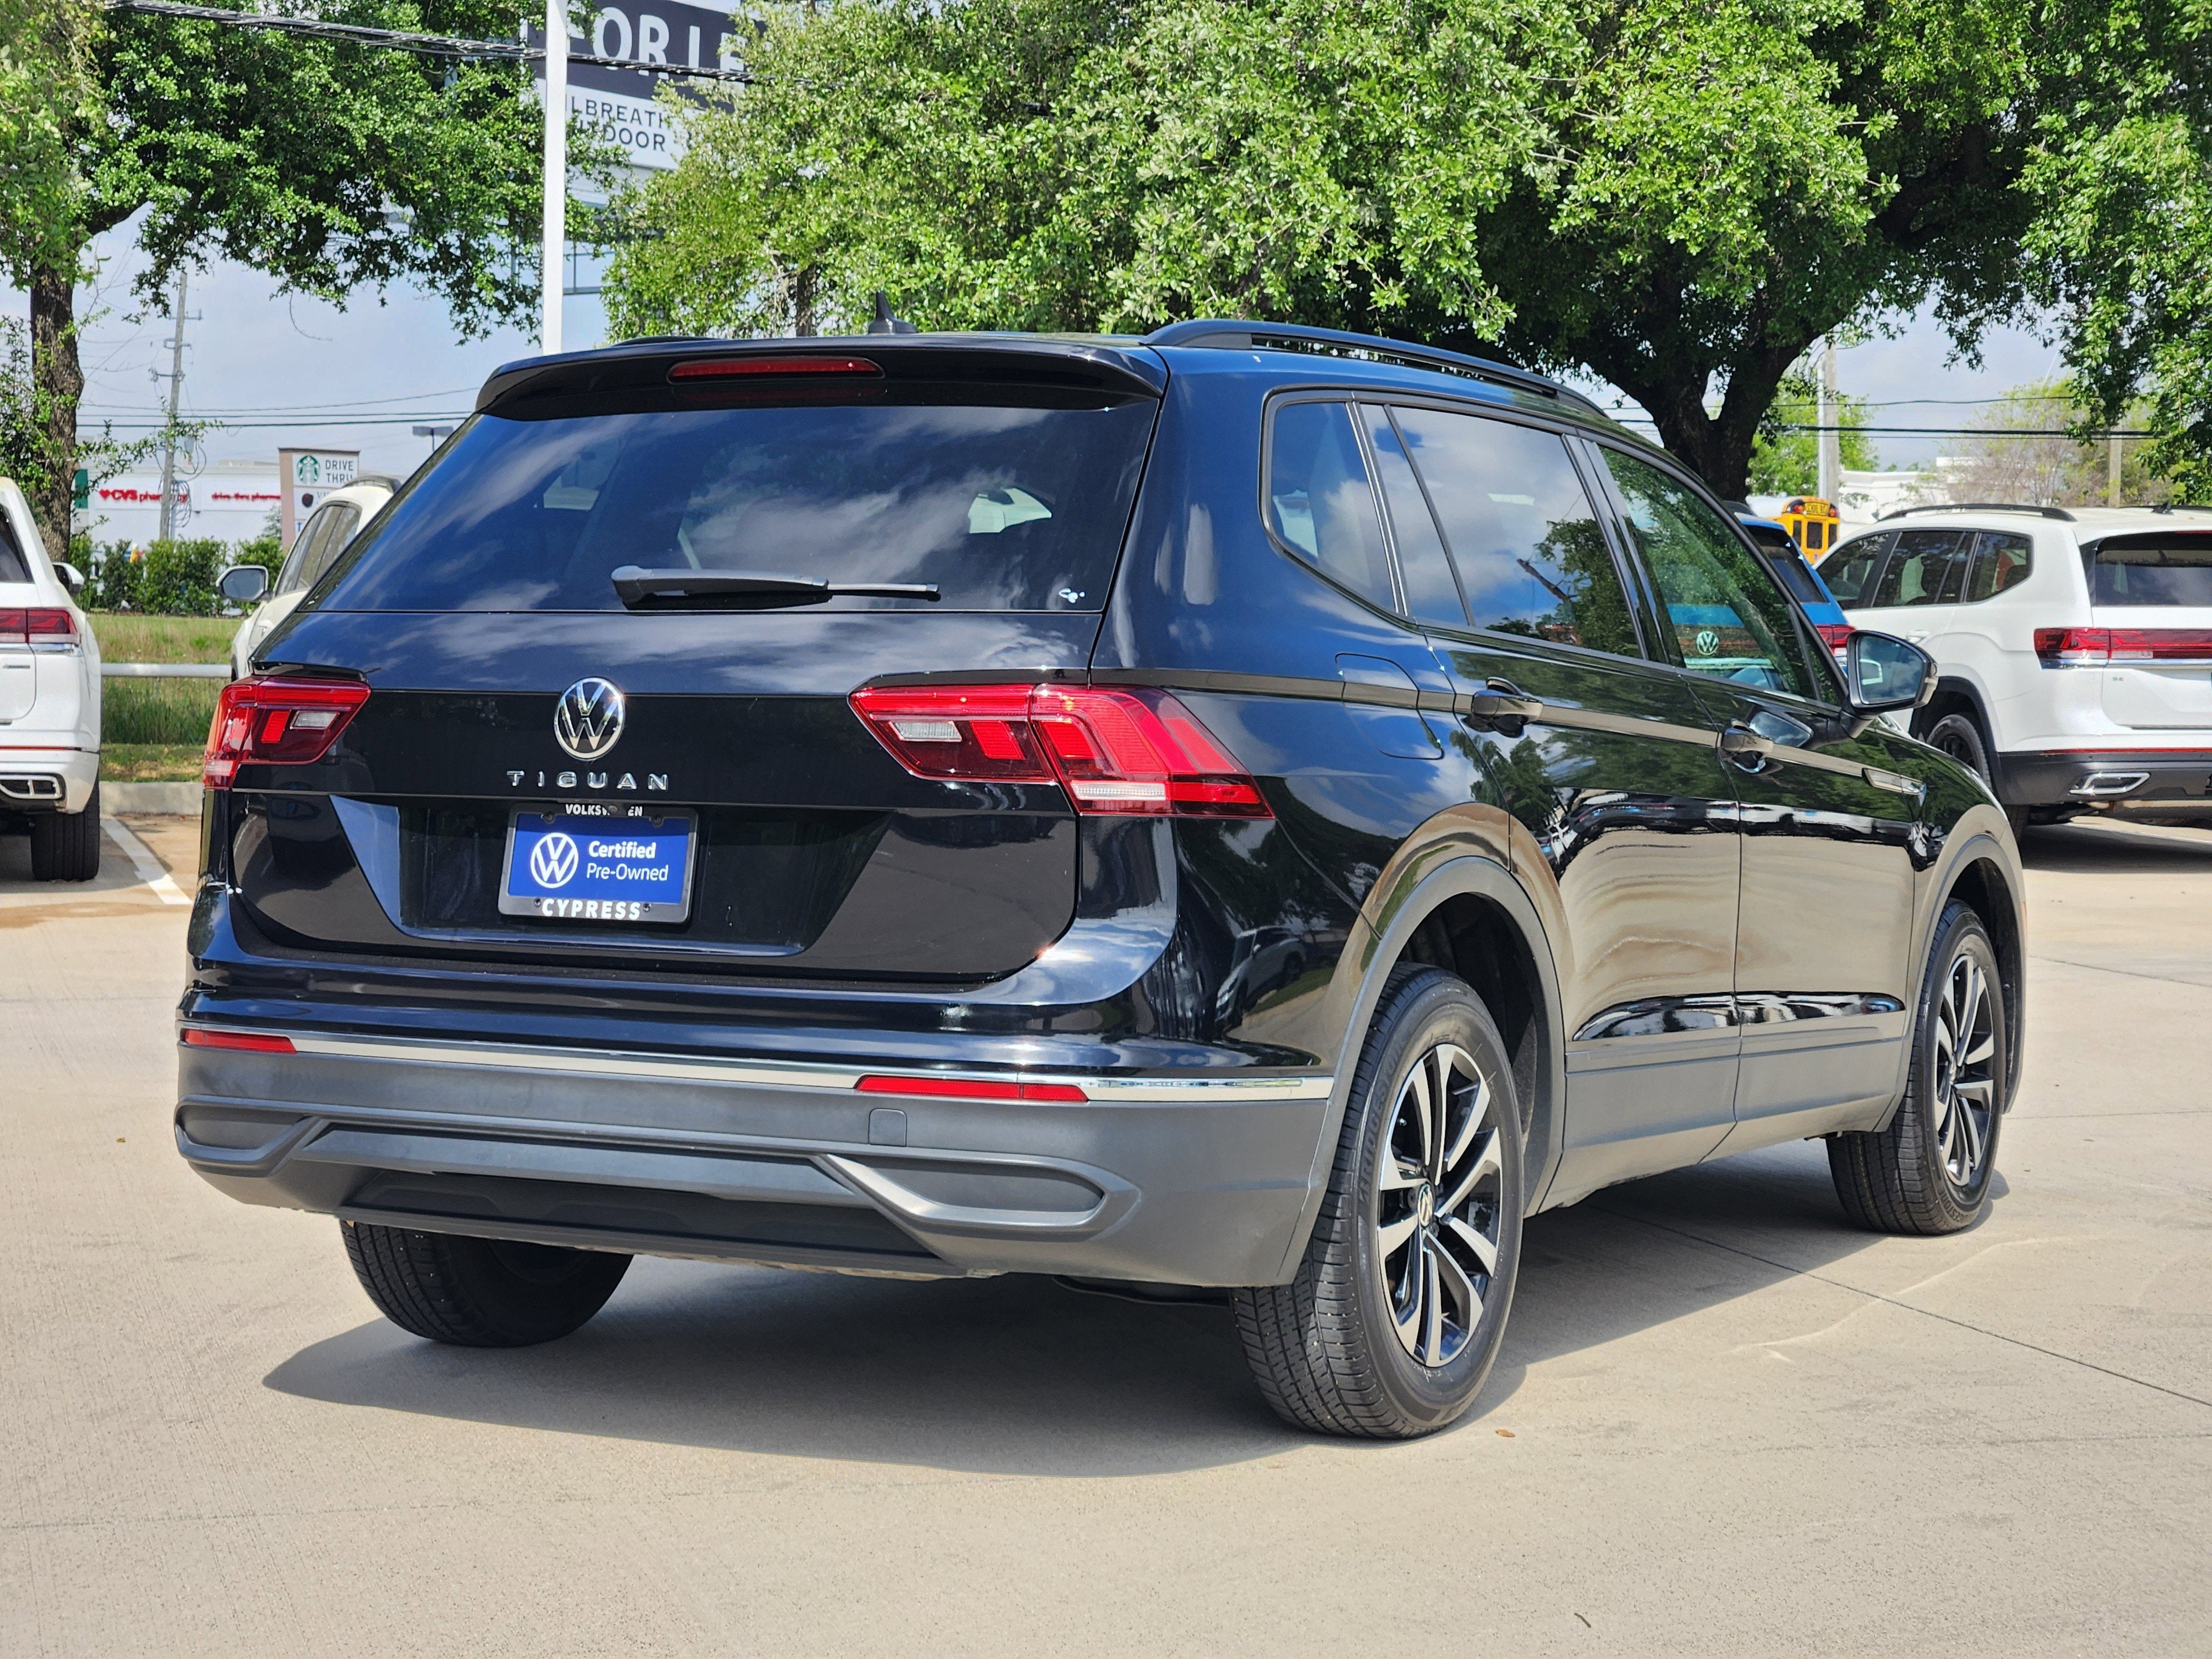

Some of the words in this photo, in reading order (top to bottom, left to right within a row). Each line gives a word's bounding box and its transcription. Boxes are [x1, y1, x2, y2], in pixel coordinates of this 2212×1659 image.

[565, 95, 664, 129] LBREAT
[580, 119, 666, 152] DOOR
[325, 460, 354, 471] DRIVE
[112, 489, 138, 501] CVS
[251, 492, 281, 502] pharma
[506, 770, 669, 791] TIGUAN
[565, 804, 643, 817] VOLKSEN
[588, 841, 656, 859] Certified
[586, 863, 669, 881] Pre-Owned
[541, 898, 641, 921] CYPRESS
